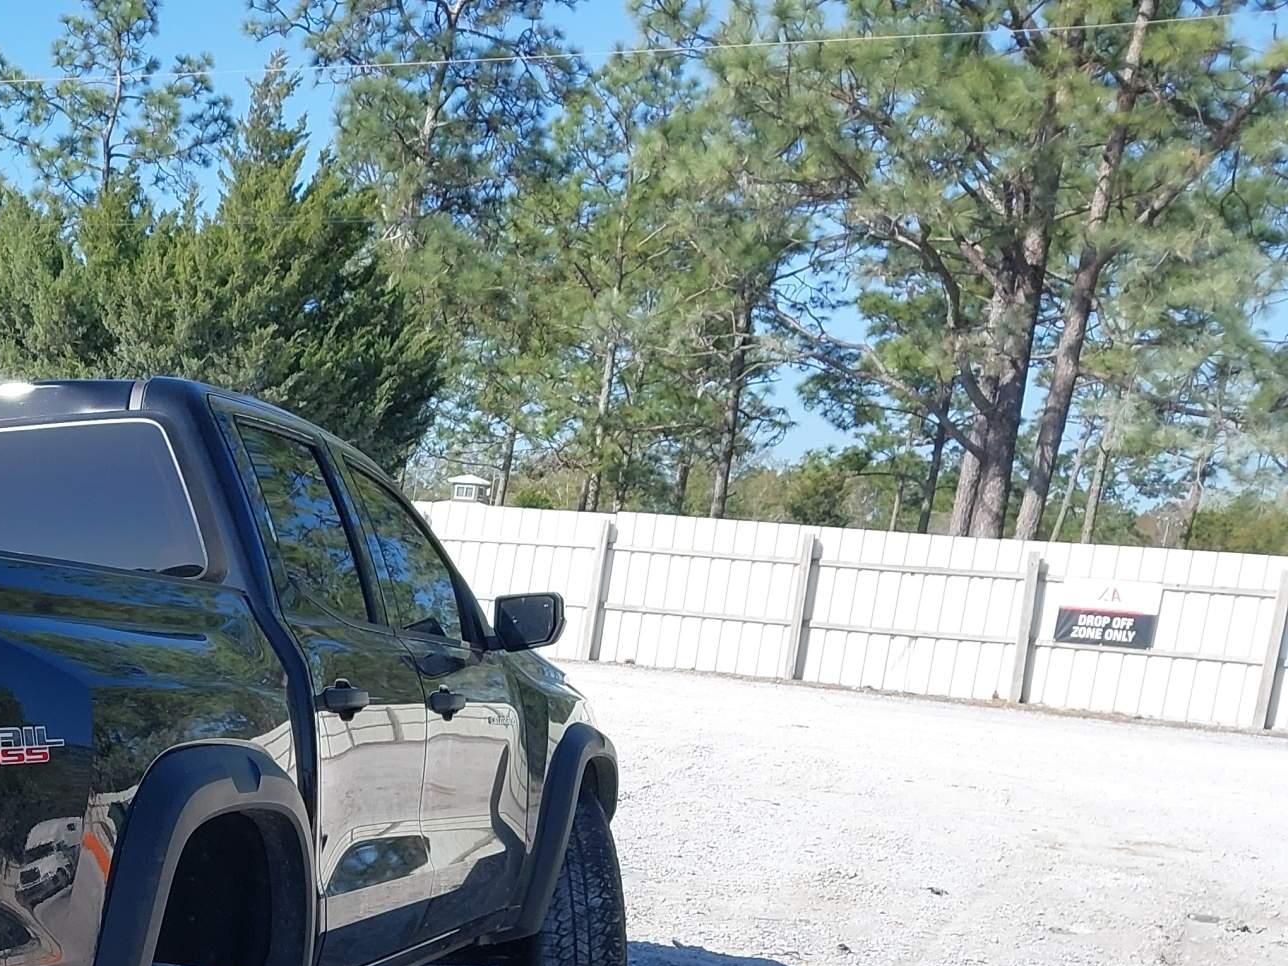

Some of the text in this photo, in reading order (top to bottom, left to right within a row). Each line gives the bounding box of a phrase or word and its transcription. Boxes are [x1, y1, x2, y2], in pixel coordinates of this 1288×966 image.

[1078, 614, 1134, 629] DROP OFF
[1070, 626, 1135, 642] ZONE ONLY
